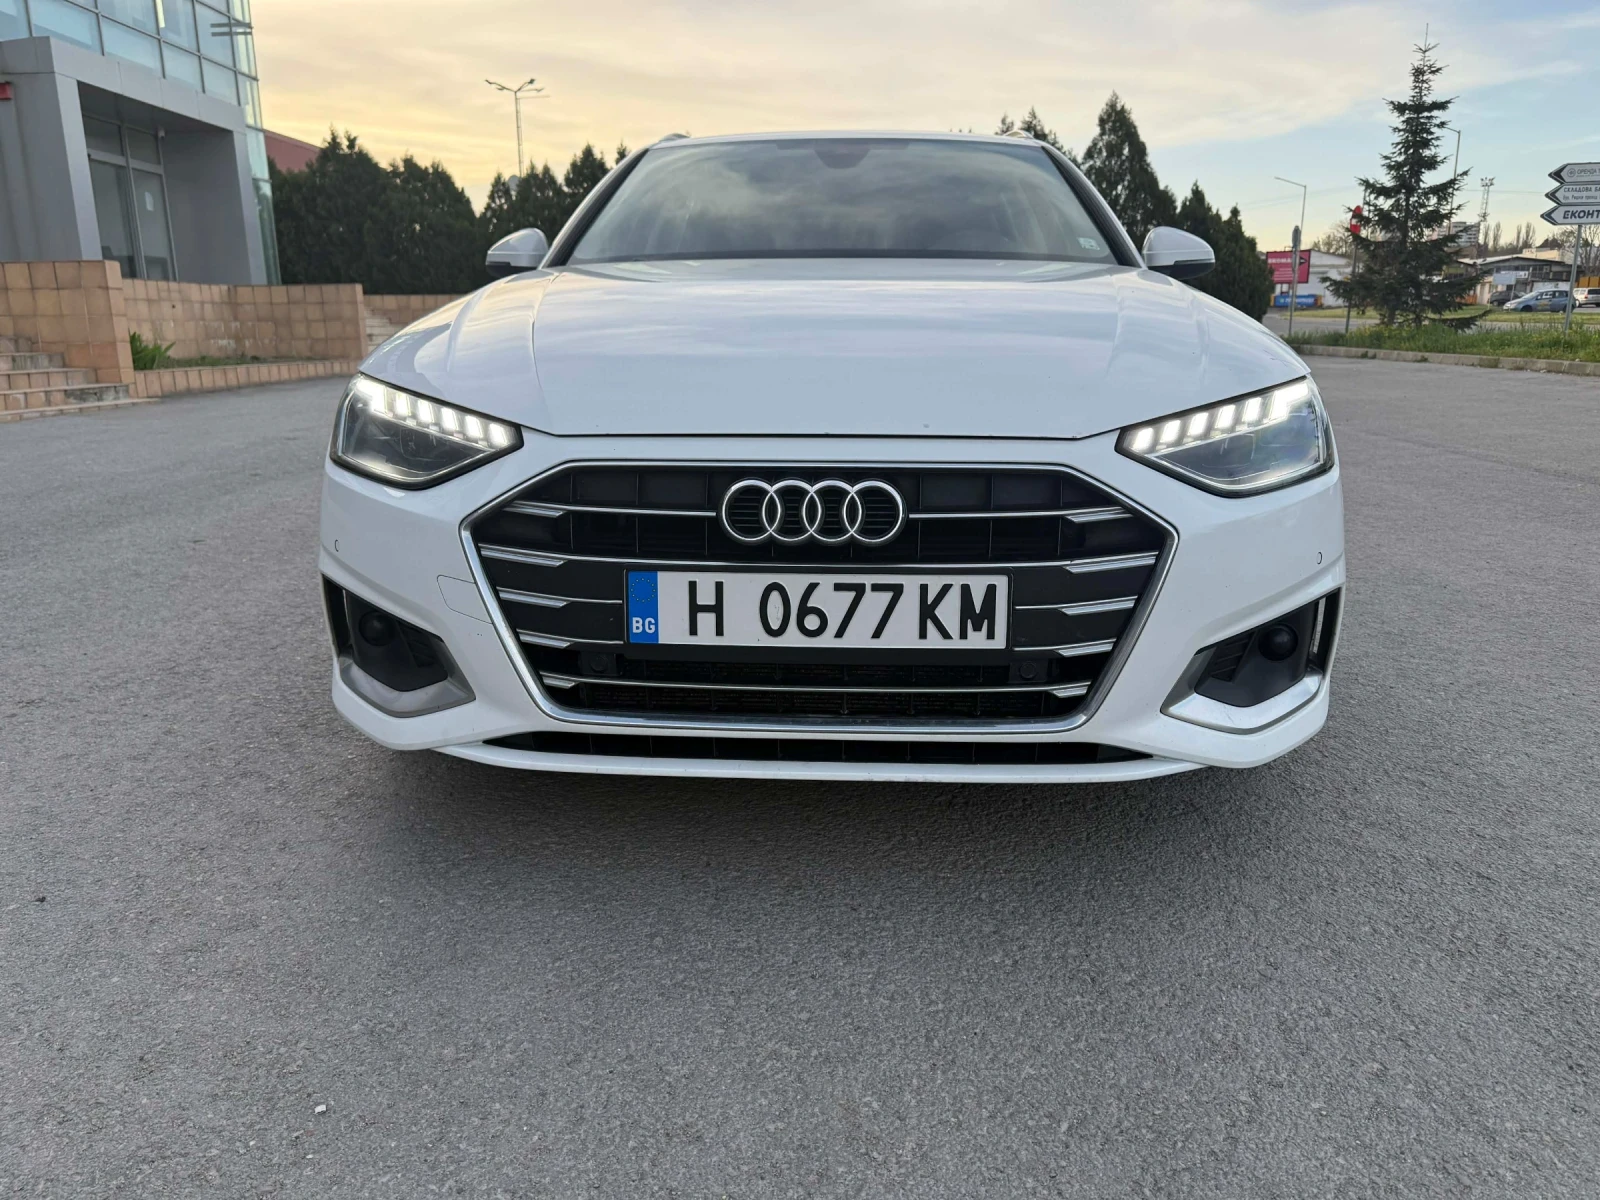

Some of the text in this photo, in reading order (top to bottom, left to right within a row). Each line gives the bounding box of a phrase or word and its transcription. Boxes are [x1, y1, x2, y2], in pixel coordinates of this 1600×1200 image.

[1563, 210, 1600, 219] ЕКОНТ
[688, 580, 997, 640] H 0677 KM
[632, 616, 656, 634] BG
